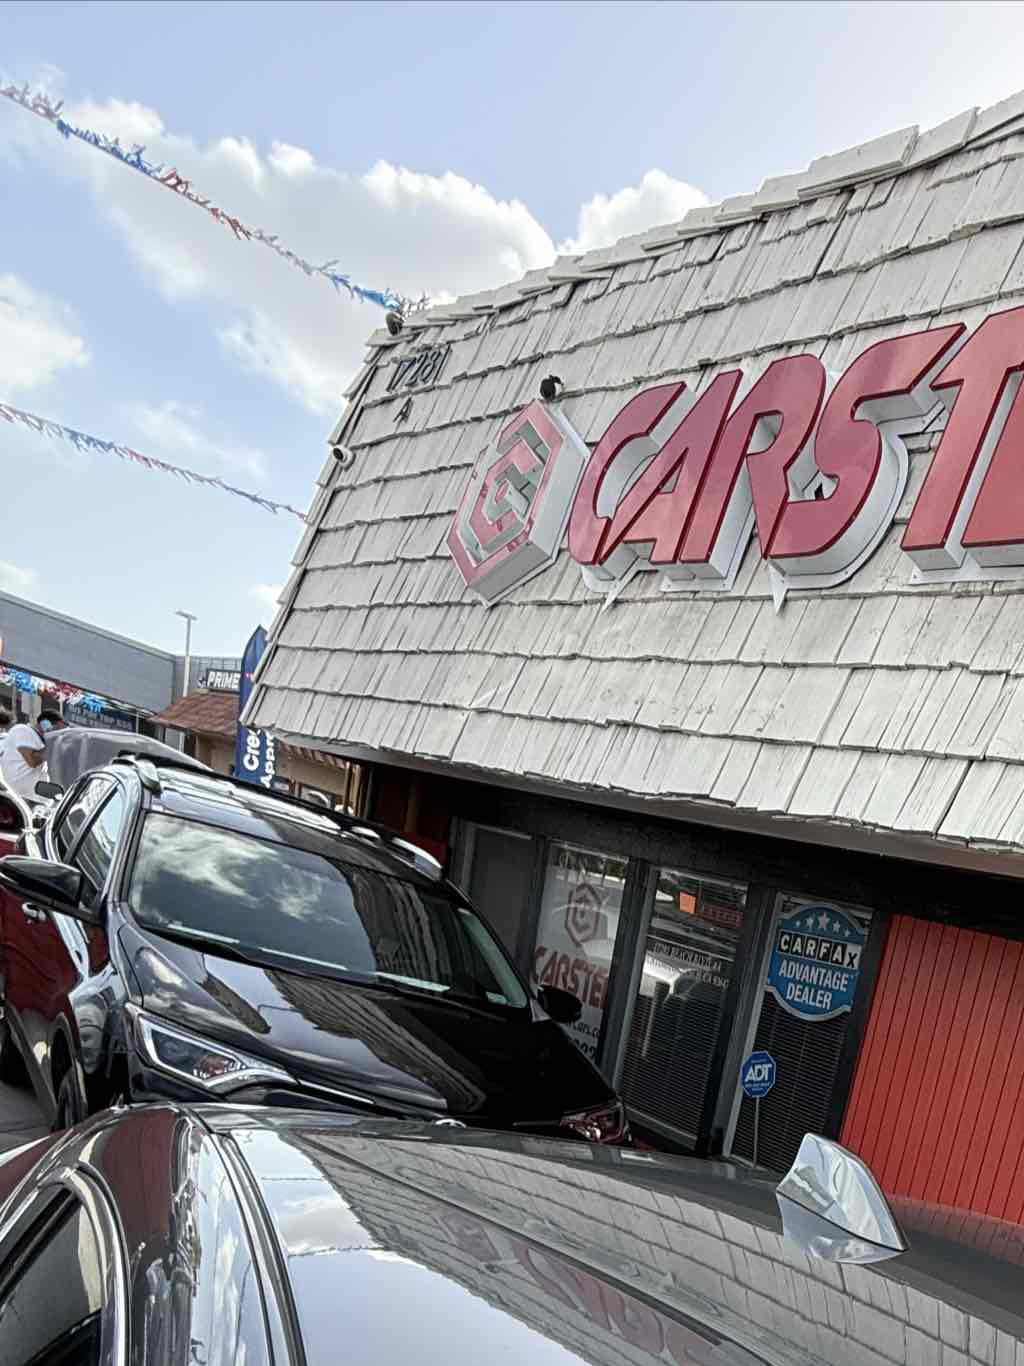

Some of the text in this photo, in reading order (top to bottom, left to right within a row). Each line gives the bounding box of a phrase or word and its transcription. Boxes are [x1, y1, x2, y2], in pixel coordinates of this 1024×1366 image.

[206, 670, 241, 689] PRIME
[780, 934, 858, 970] CARFAX
[779, 959, 849, 992] ADVANTAGE
[786, 982, 833, 1010] DEALER
[744, 1063, 772, 1082] ADT
